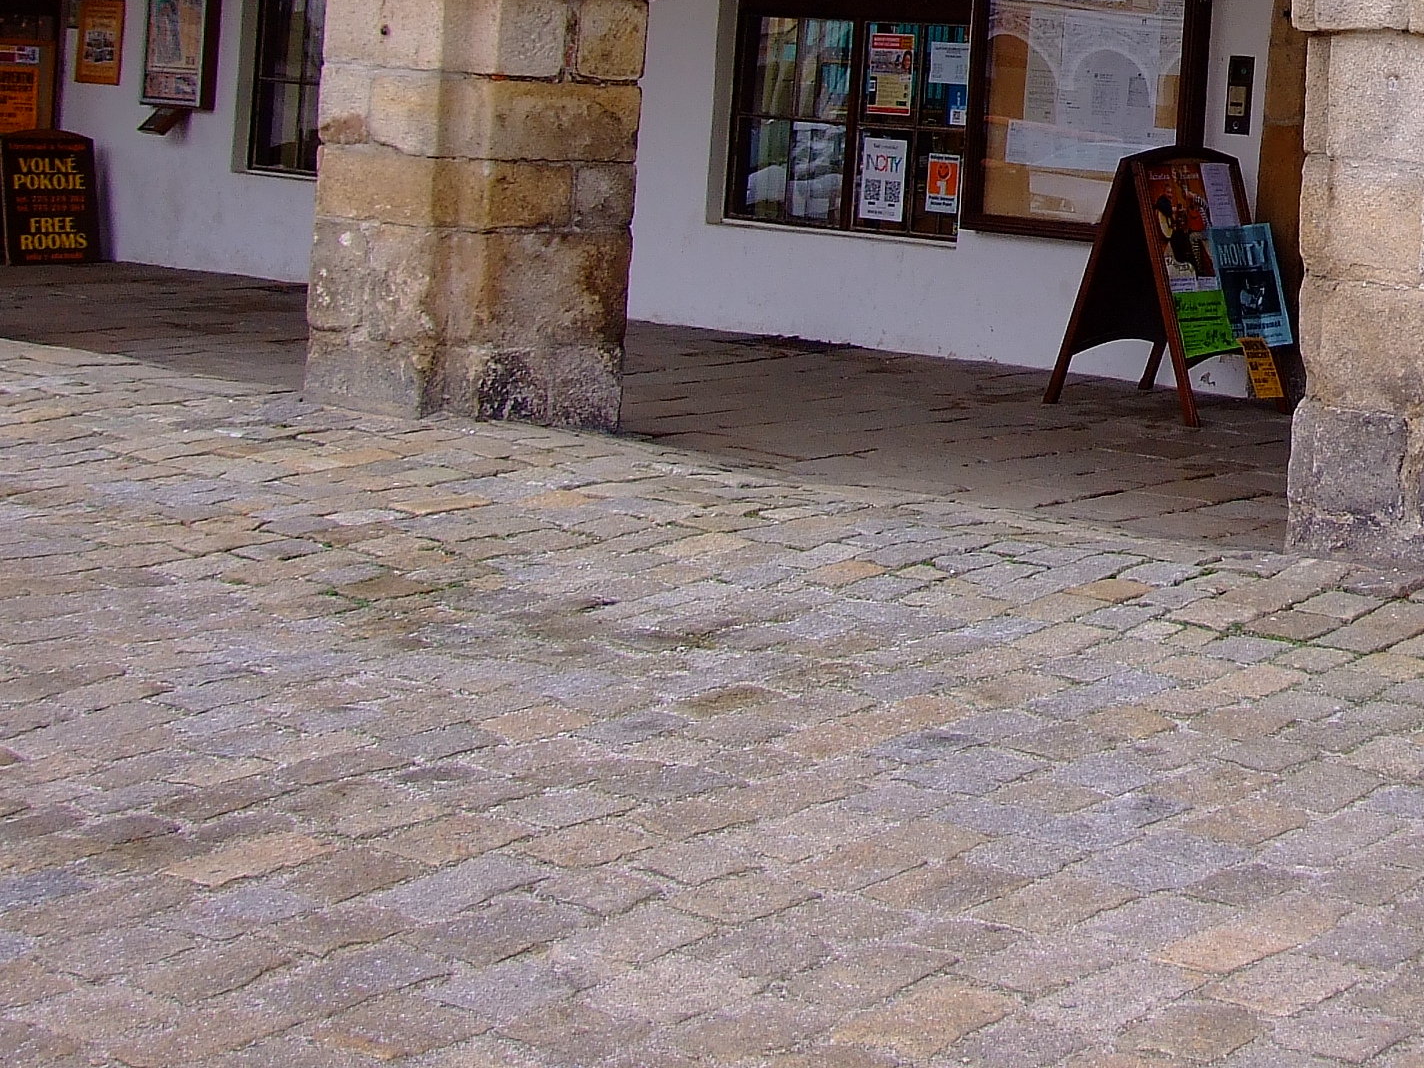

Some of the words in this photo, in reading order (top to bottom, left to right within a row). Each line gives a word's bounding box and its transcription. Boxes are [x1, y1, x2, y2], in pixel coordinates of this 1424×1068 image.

[18, 154, 79, 173] VOLNÉ
[13, 174, 86, 190] POKOJE
[29, 217, 78, 233] FREE
[20, 233, 89, 250] ROOMS
[1217, 240, 1266, 266] MONTY
